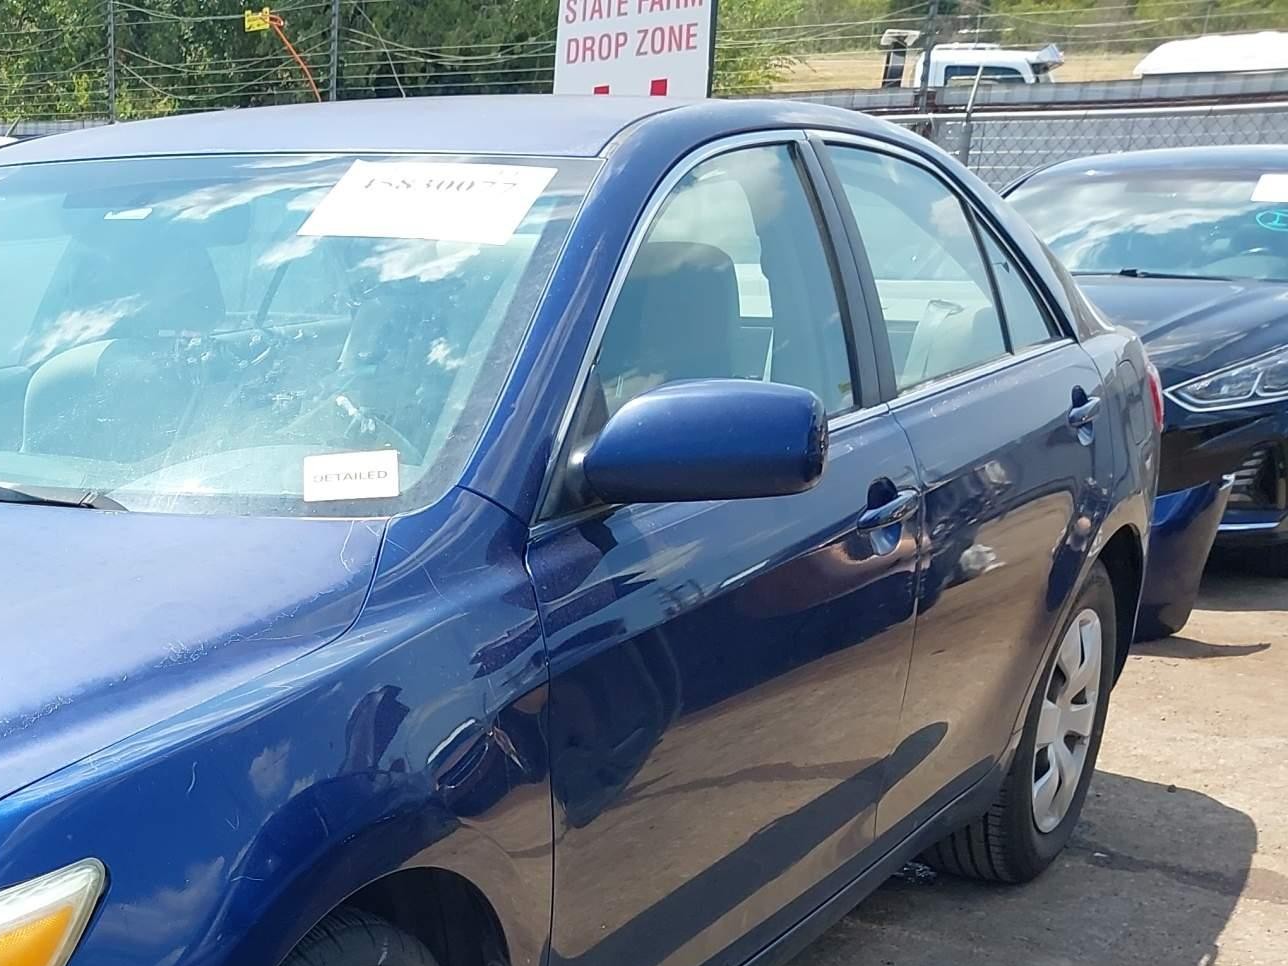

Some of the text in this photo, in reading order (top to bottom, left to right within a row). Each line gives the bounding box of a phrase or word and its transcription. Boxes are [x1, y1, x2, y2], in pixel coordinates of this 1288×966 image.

[565, 0, 628, 24] STATE
[566, 23, 698, 64] DROP ZONE
[313, 470, 388, 482] DETAILED
